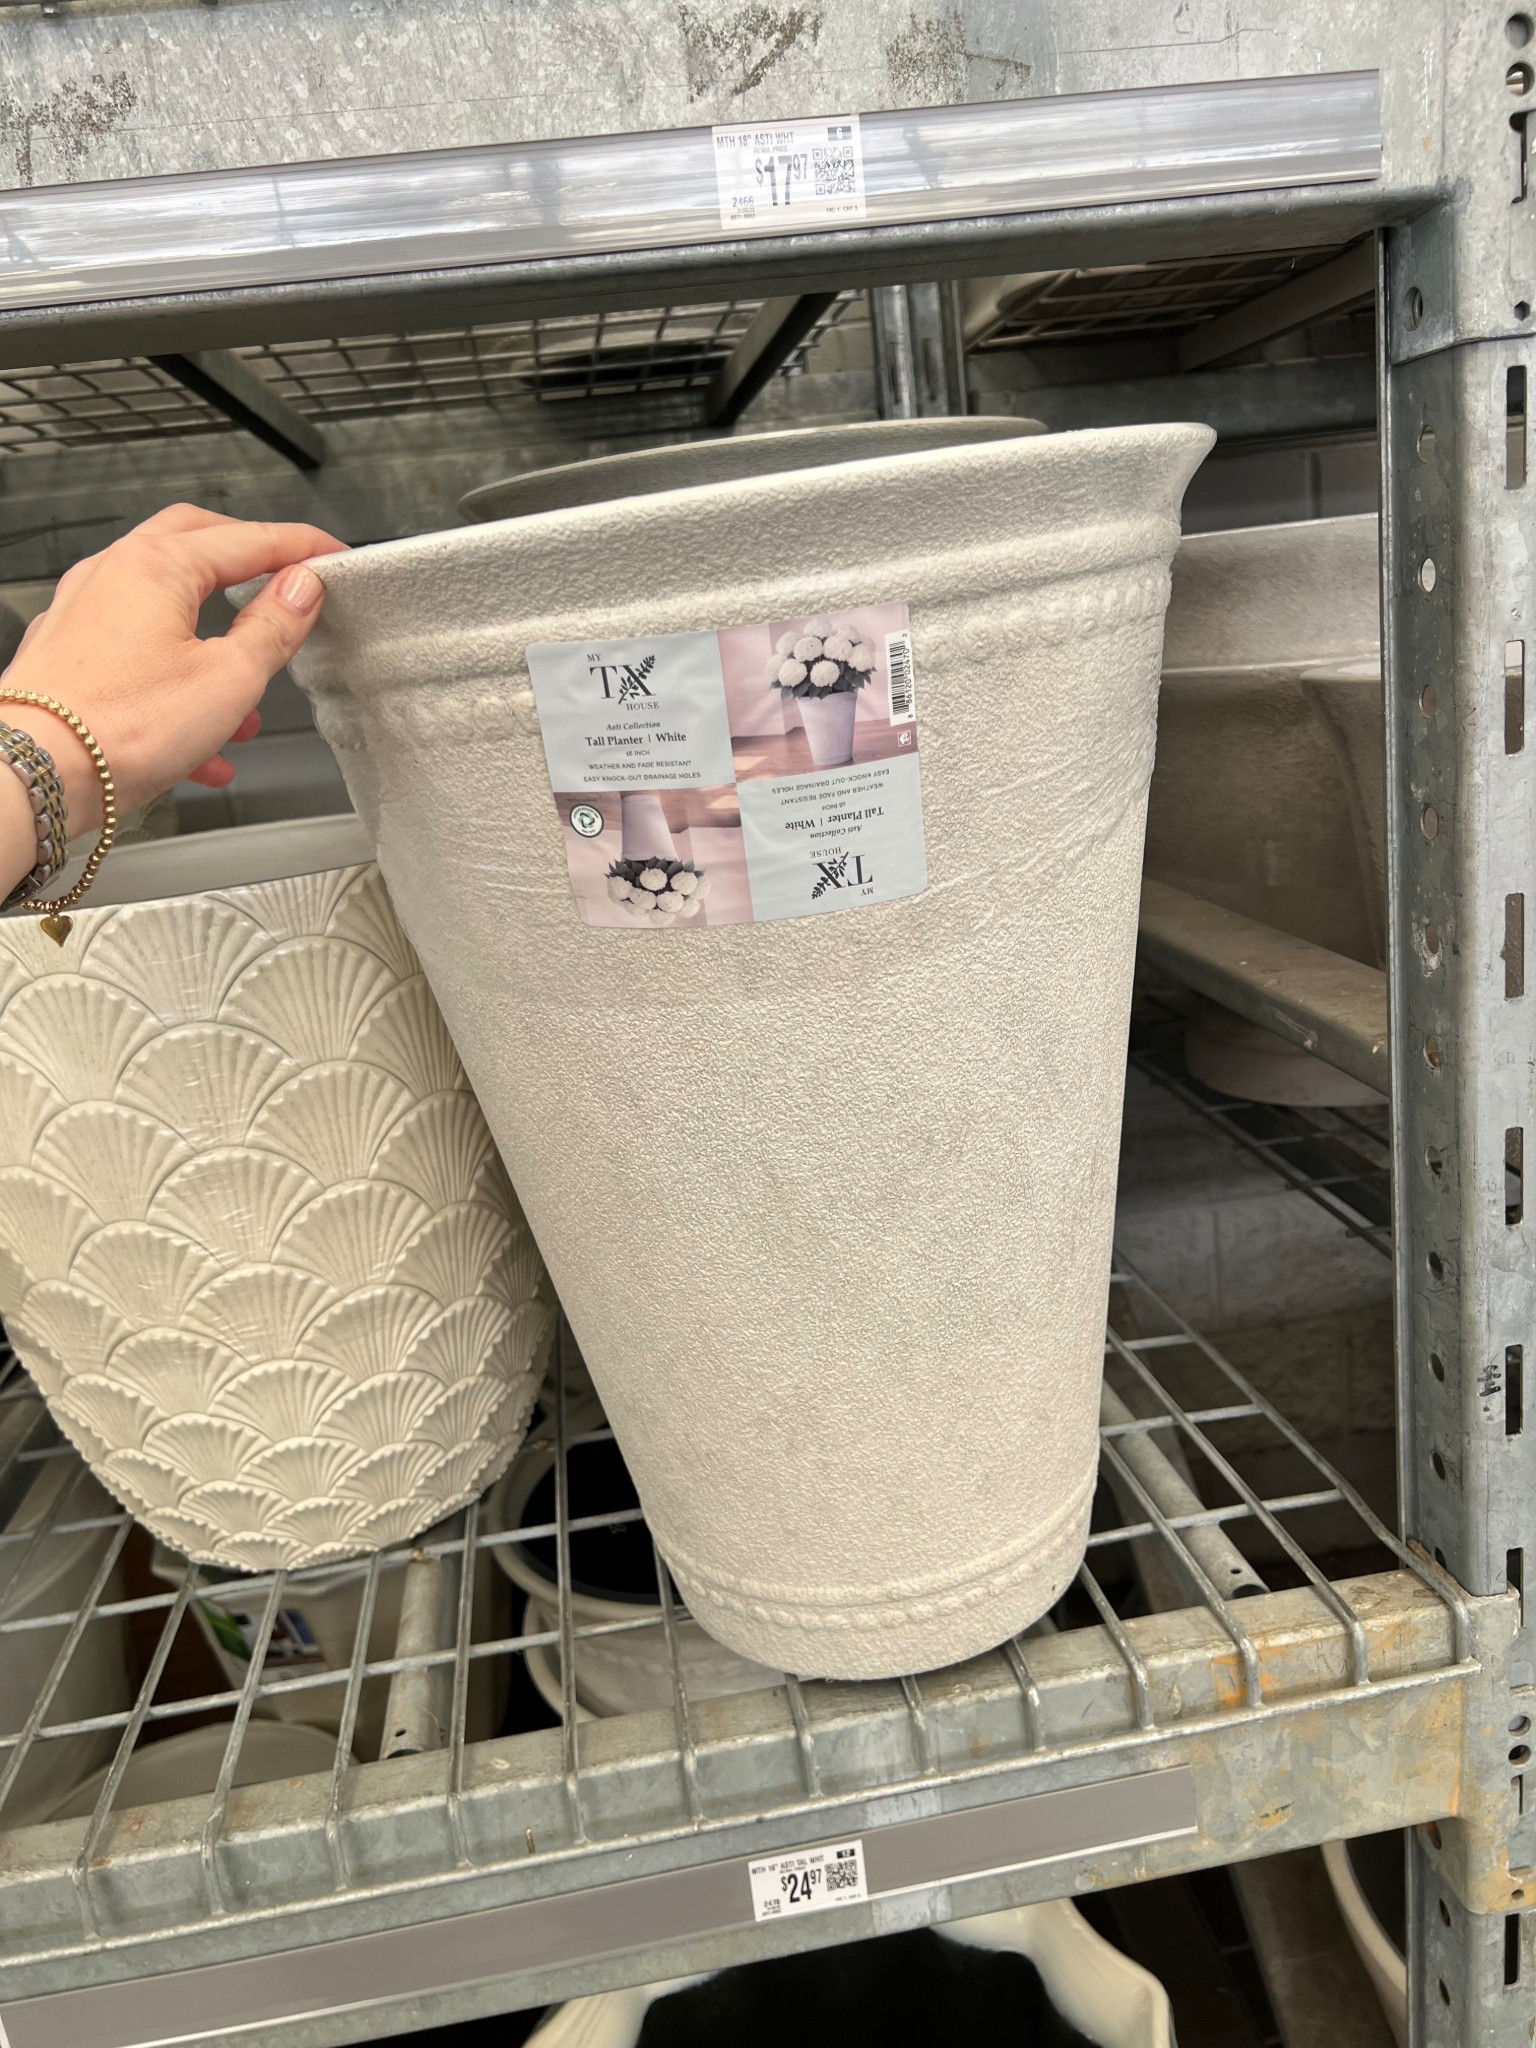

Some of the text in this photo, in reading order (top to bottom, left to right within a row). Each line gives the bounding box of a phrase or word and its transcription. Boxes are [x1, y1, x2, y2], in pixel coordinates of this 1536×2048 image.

[835, 127, 843, 139] 6
[716, 136, 735, 148] MTH
[754, 133, 773, 146] ASTI
[776, 131, 794, 144] WHT
[587, 653, 601, 662] MY
[902, 648, 910, 675] 02470
[589, 659, 657, 703] TX
[626, 701, 660, 712] HOUSE
[606, 721, 661, 731] Asti Collection
[585, 736, 606, 747] Tall
[608, 734, 643, 747] Planter
[656, 731, 687, 743] White
[588, 762, 621, 770] WEATHER
[637, 761, 655, 769] FADE
[656, 760, 692, 768] RESISTANT
[583, 772, 701, 783] EASY KNOCK-OUT DRAINAGE HOLES
[771, 768, 890, 795] EASY KNOCK-OUT DRAINAGE HOLES
[781, 782, 884, 806] WEATHER AND FADE RESISTANT
[822, 803, 838, 811] INCH
[864, 806, 885, 818] Tall
[827, 810, 863, 824] Planter
[785, 818, 816, 830] White
[809, 824, 863, 839] Asti Collection
[809, 847, 842, 859] HOUSE
[812, 853, 873, 894] TX
[860, 887, 874, 896] MY
